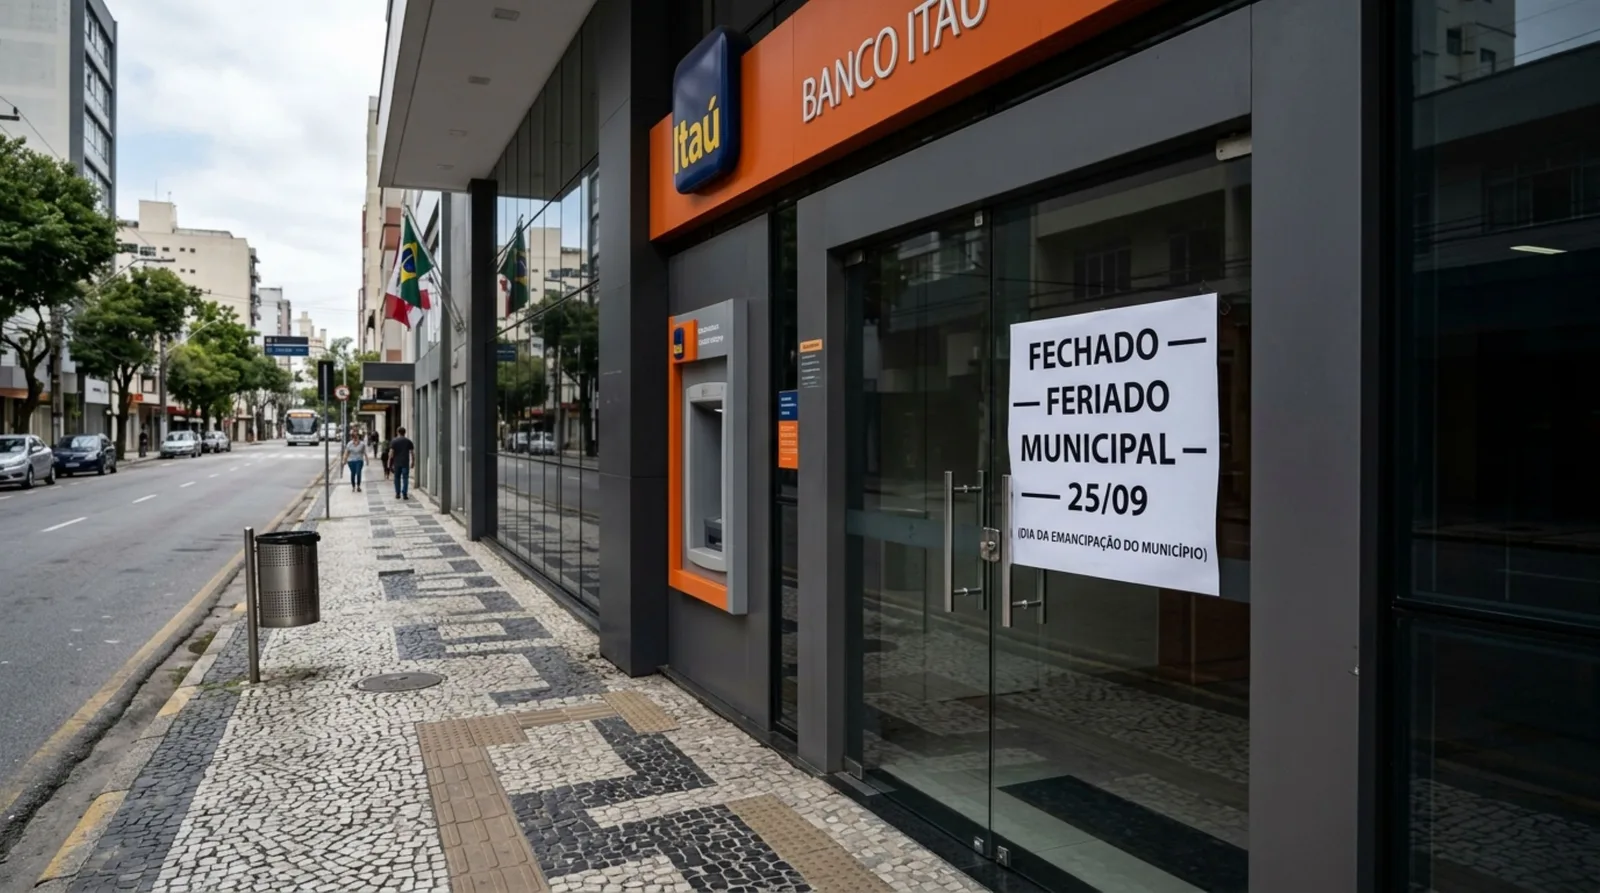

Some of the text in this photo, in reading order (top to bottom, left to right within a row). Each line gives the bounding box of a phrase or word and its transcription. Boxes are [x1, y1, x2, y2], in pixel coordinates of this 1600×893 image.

[803, 26, 898, 123] BANCO
[674, 95, 720, 174] Itaú
[1029, 327, 1159, 371] FECHADO
[1047, 379, 1170, 416] FERIADO
[1021, 432, 1176, 466] MUNICIPAL
[1067, 481, 1148, 517] 25/09
[1018, 527, 1036, 540] (DIA
[1037, 529, 1050, 542] DA
[1051, 531, 1122, 552] EMANCIPAÇÃO
[1123, 539, 1140, 553] DO
